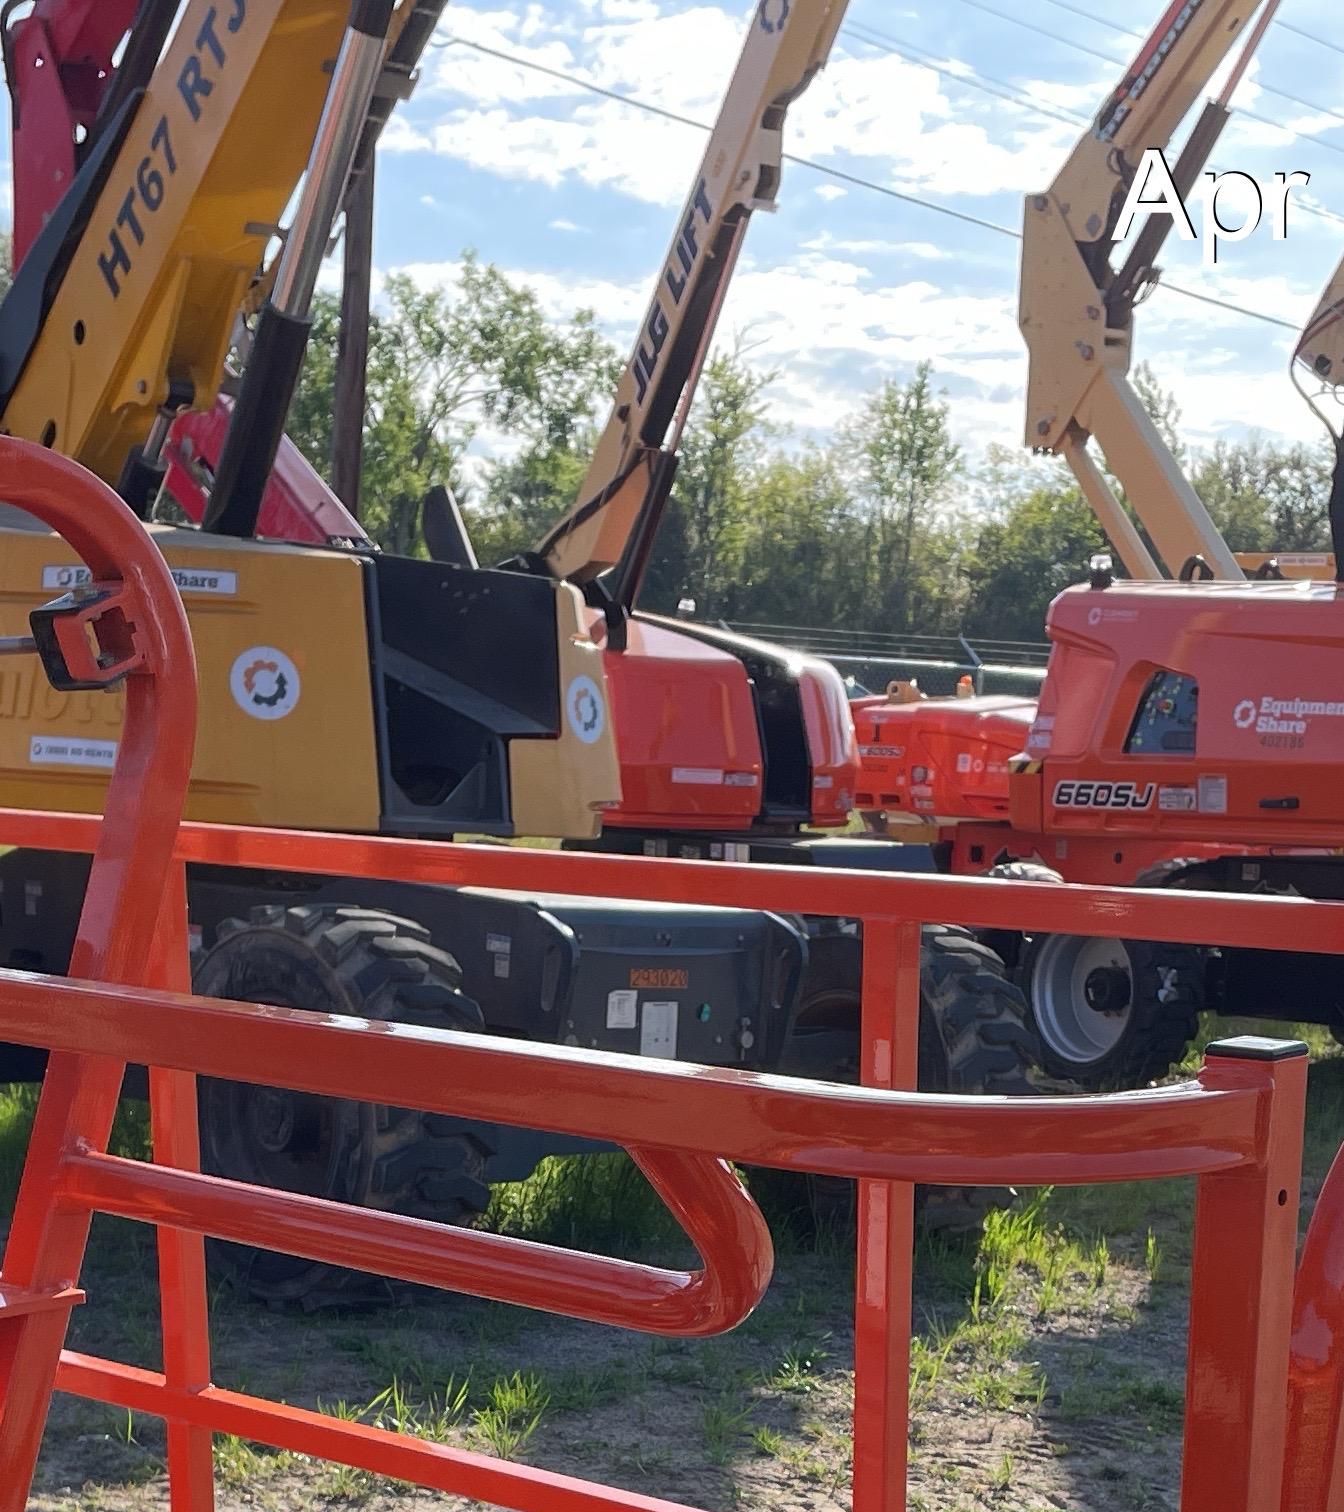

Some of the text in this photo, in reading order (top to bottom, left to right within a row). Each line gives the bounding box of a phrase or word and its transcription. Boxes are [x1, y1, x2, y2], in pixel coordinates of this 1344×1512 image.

[97, 114, 176, 299] HT67
[633, 178, 712, 406] JLG LIFT
[1256, 716, 1307, 733] Share
[1054, 781, 1155, 810] 660SJ
